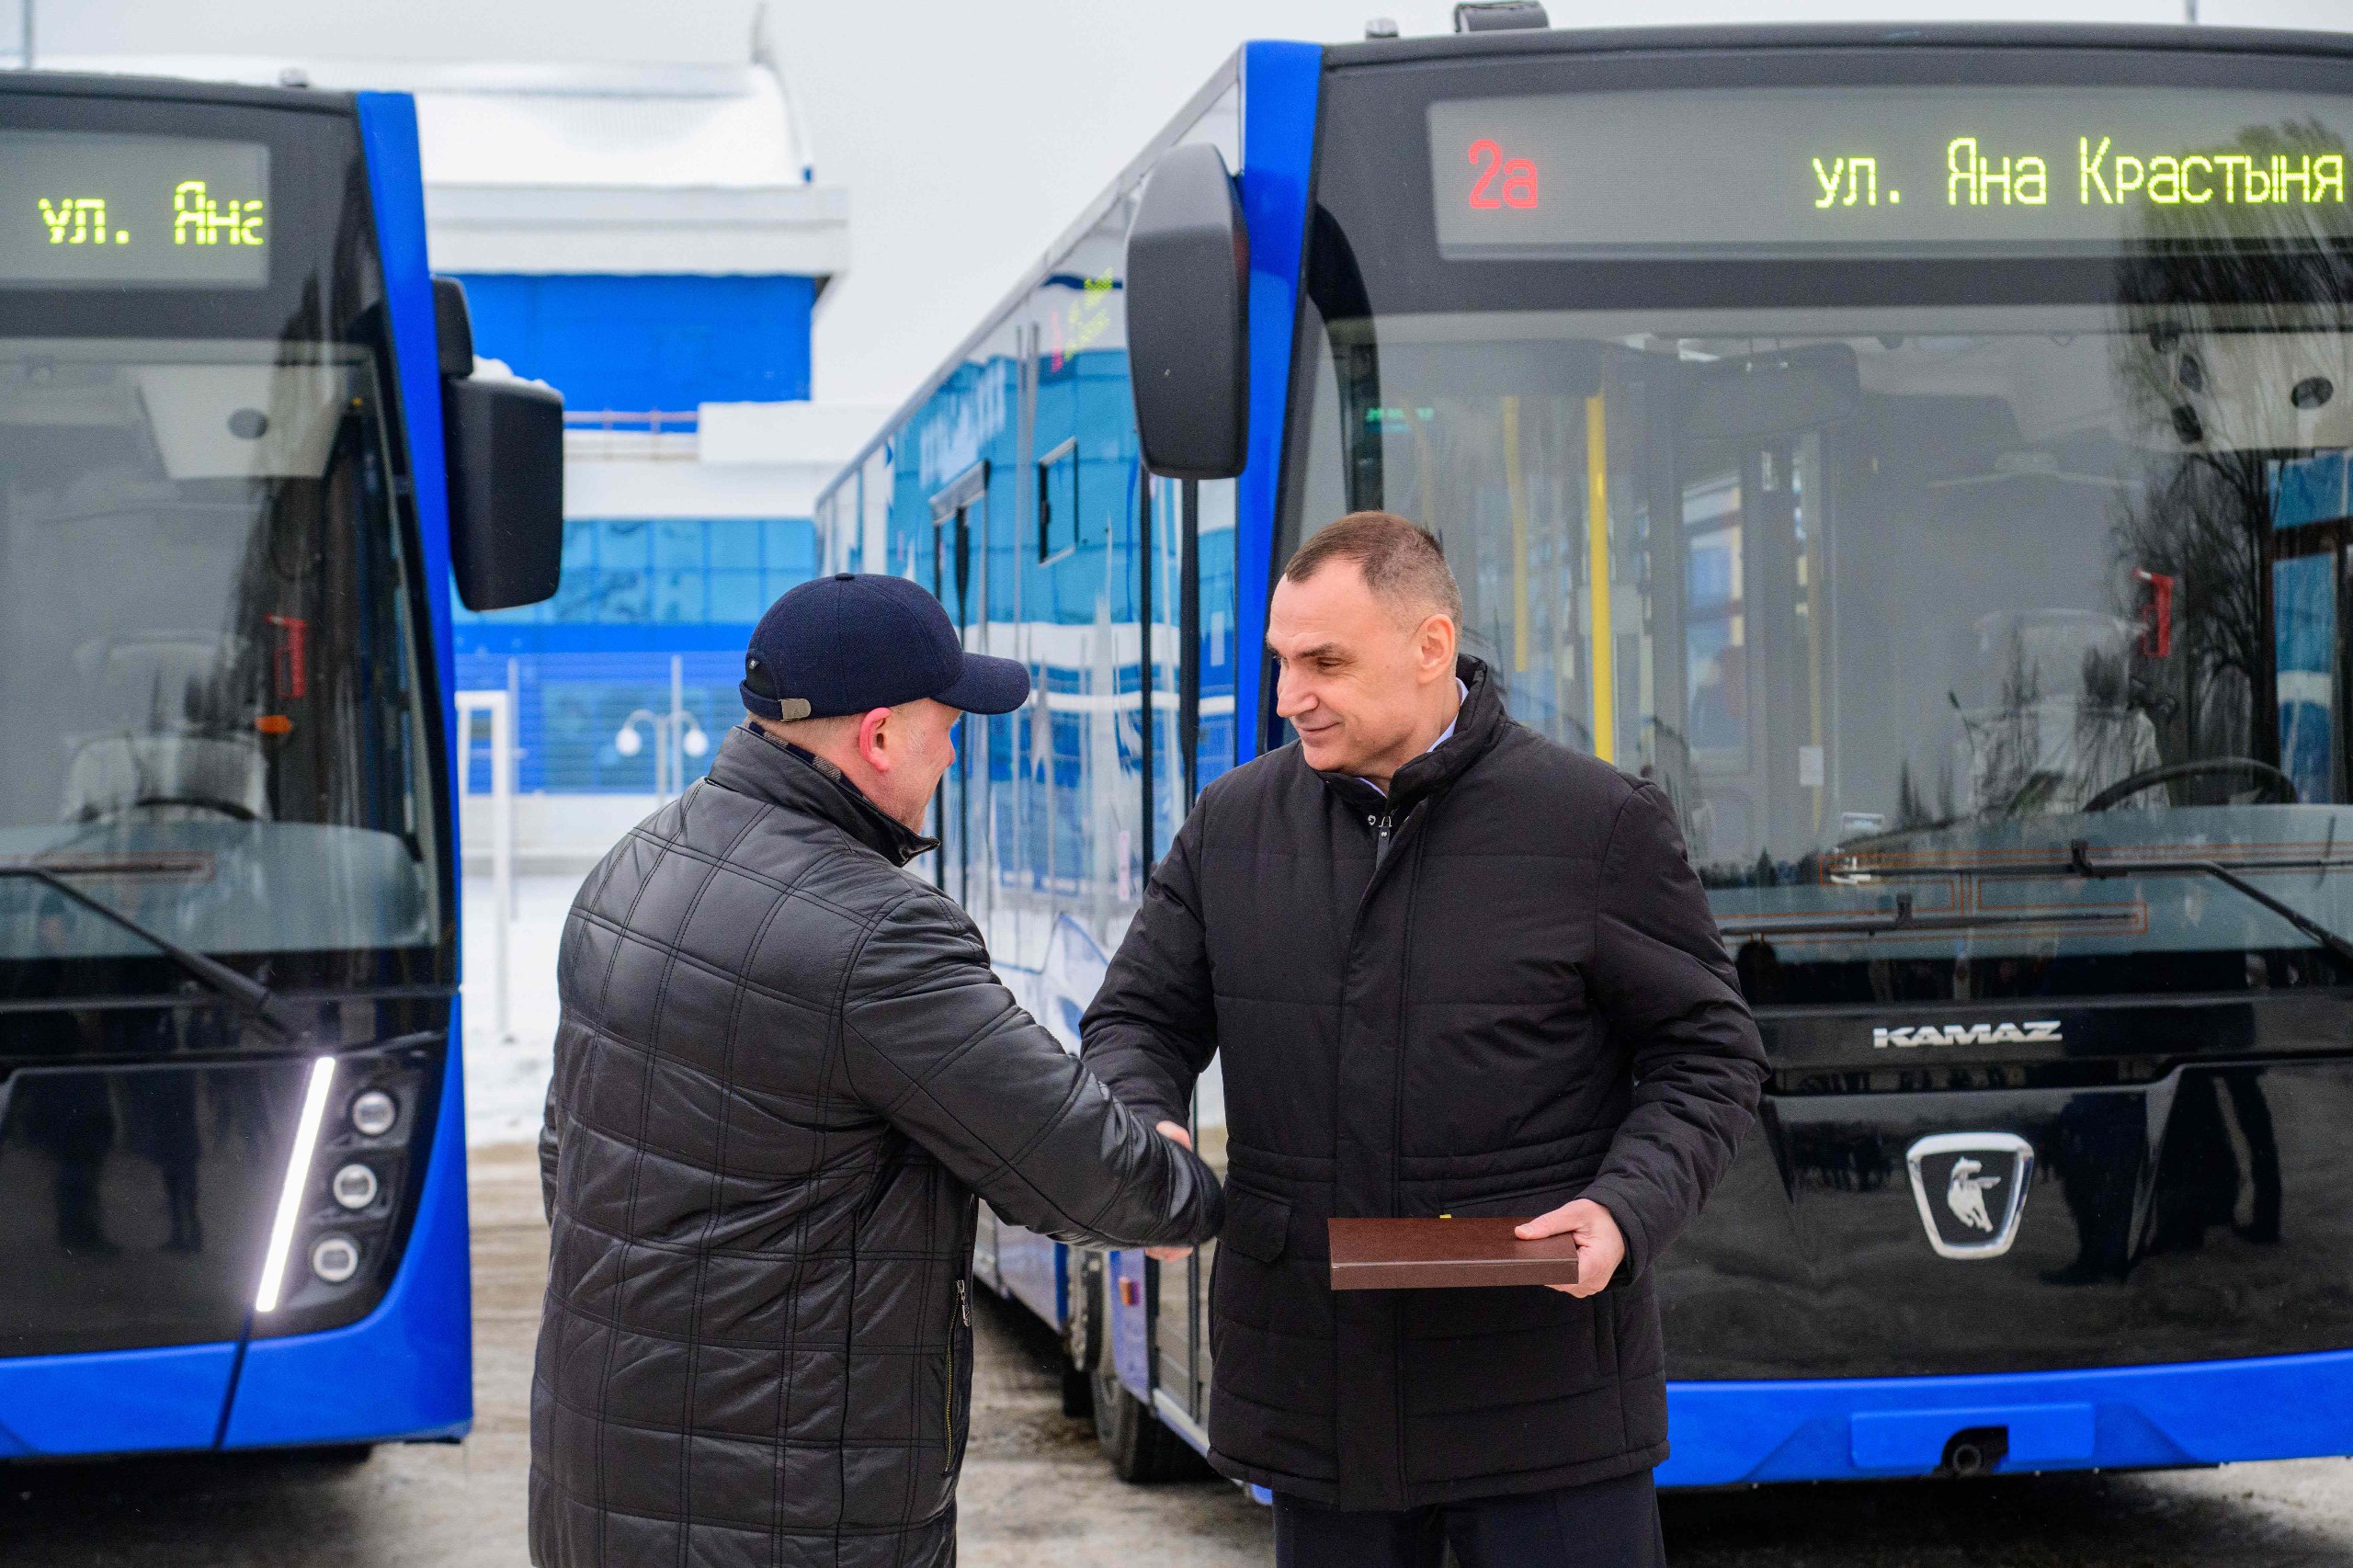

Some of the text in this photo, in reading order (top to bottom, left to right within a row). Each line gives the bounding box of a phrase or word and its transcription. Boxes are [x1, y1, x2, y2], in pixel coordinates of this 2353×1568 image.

[1812, 136, 2344, 209] ул. Яна Крастыня
[38, 198, 130, 244] ул.
[1872, 1020, 2063, 1049] KAMAZ
